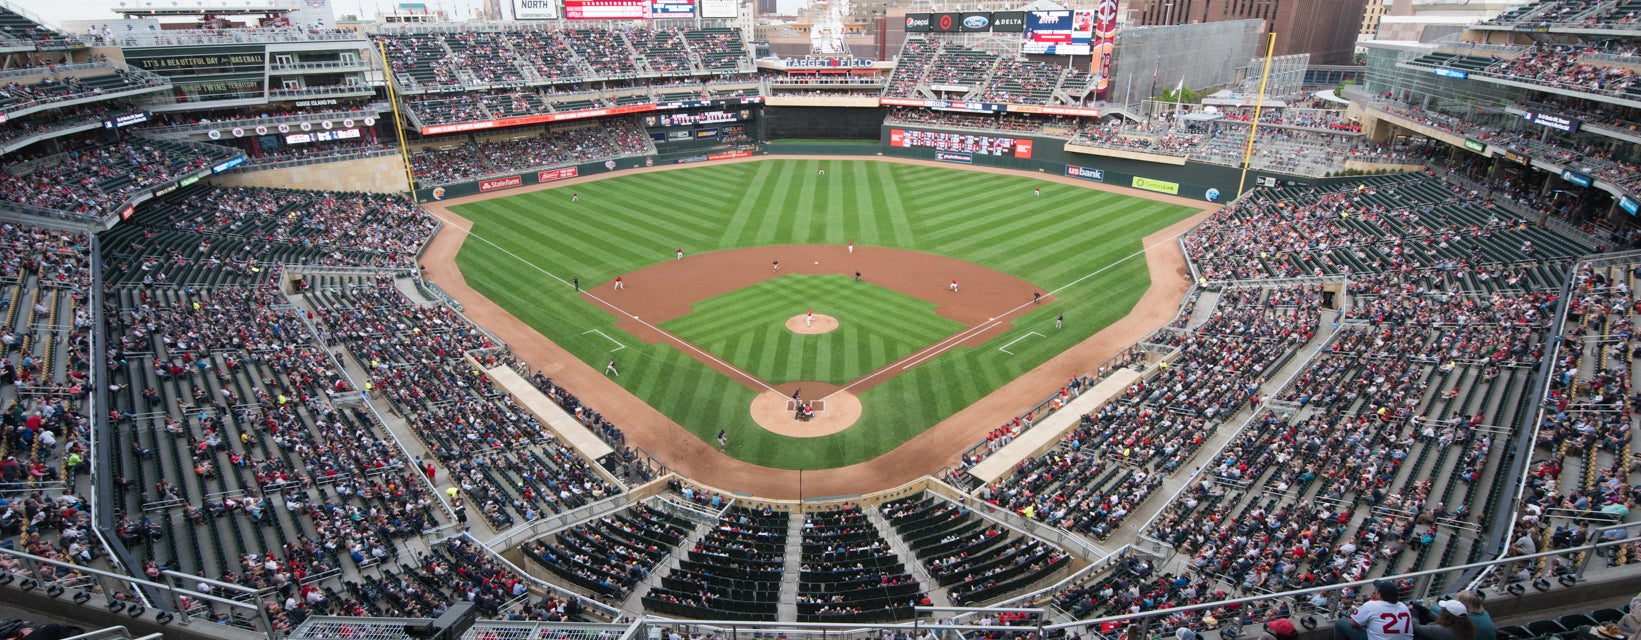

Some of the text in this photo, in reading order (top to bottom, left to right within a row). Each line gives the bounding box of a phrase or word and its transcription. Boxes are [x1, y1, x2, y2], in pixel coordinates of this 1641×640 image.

[521, 0, 548, 9] NORTH
[913, 19, 929, 27] pepsi
[142, 60, 160, 69] IT'S
[167, 58, 206, 67] BEAUTIFUL
[206, 57, 218, 65] DAY
[230, 55, 263, 65] BASEBALL
[784, 59, 873, 67] TARGET FIELD
[202, 83, 227, 92] TWINS
[227, 81, 258, 90] TERRITORY
[1380, 612, 1410, 634] 27
